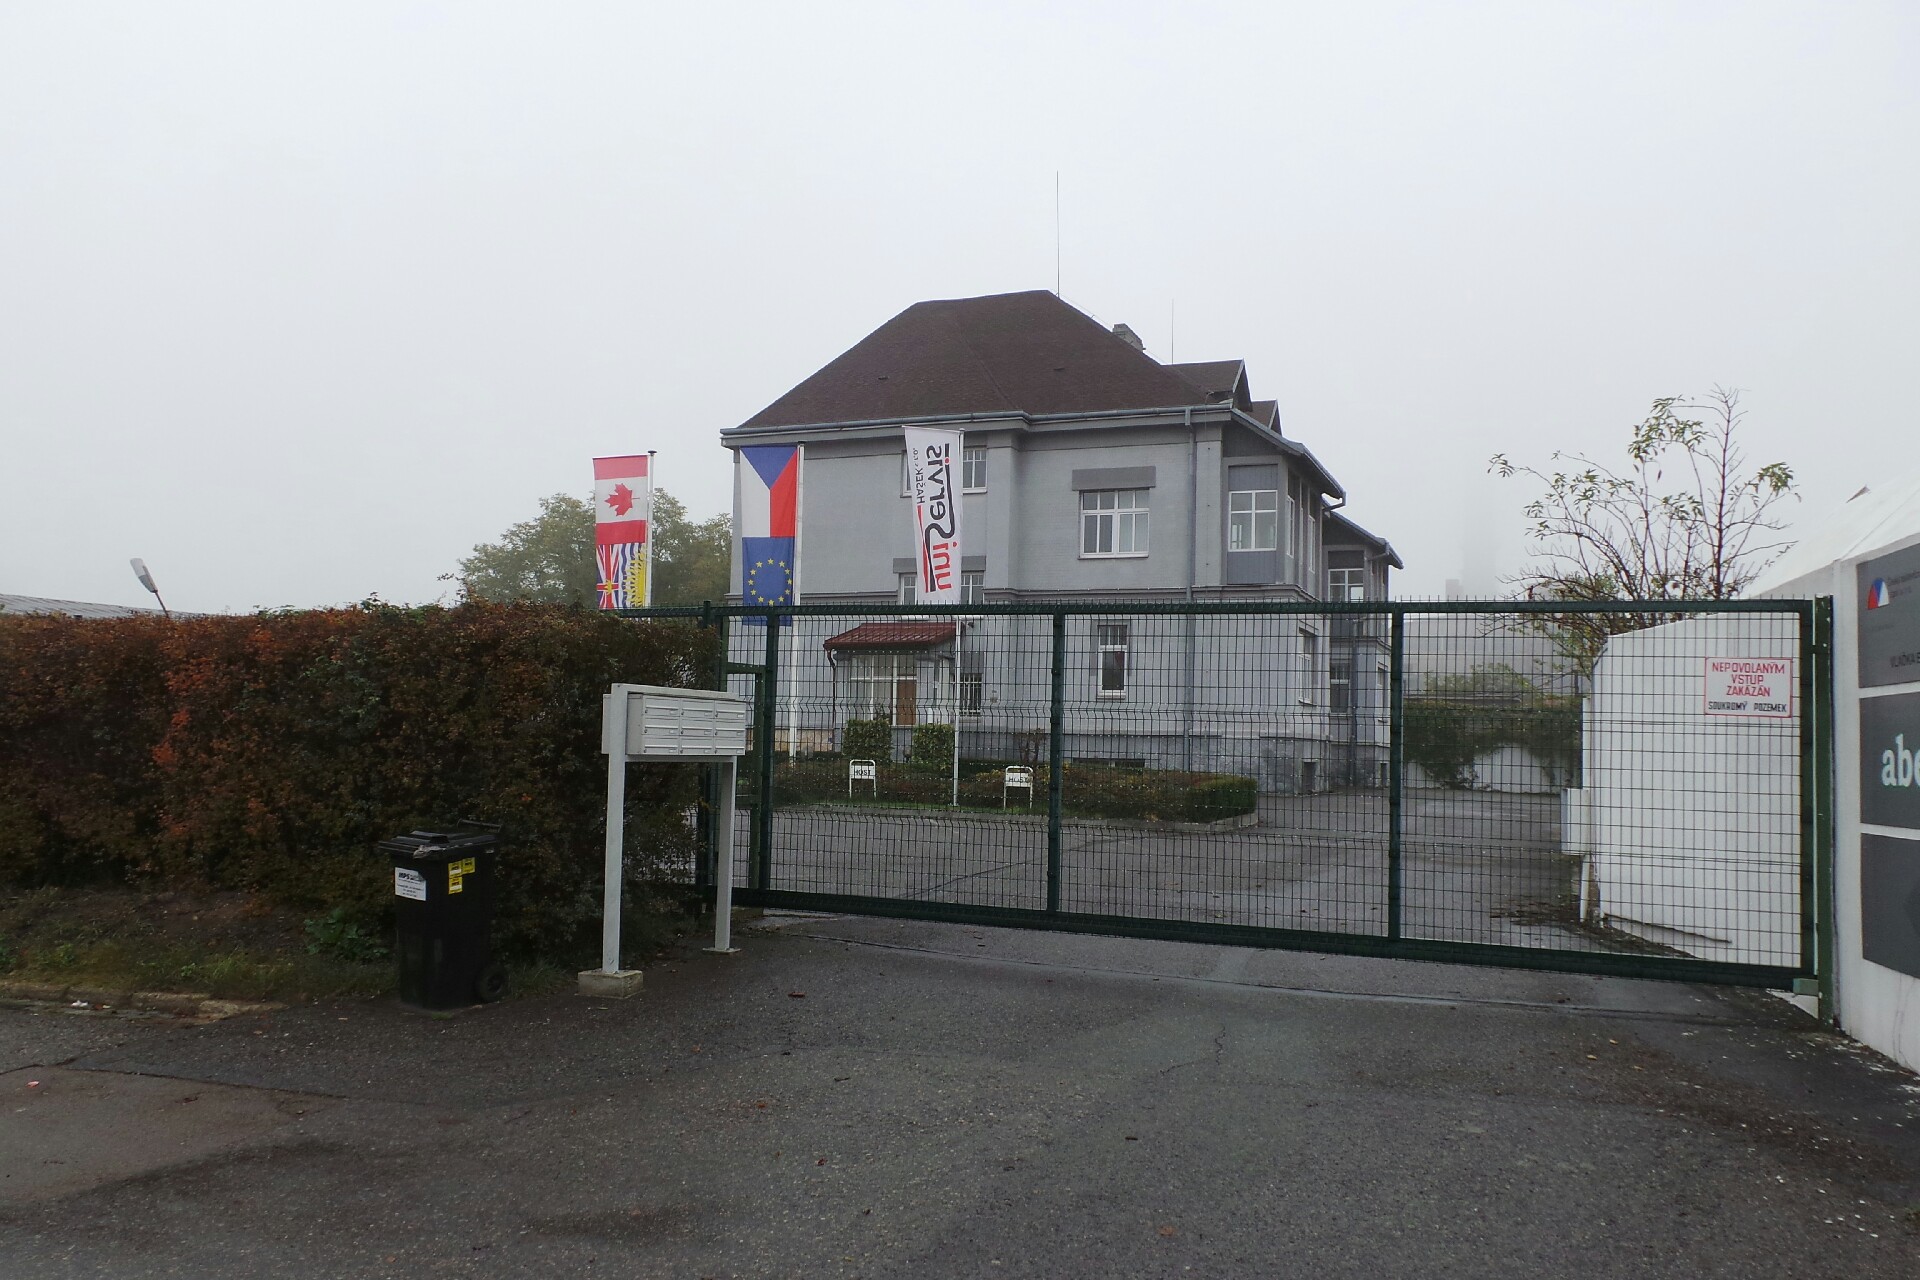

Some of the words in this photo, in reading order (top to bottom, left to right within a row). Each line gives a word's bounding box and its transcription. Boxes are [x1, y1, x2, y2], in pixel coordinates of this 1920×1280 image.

[1712, 662, 1785, 674] NEPOVOLANÝM
[1731, 674, 1764, 684] VSTUP
[1726, 685, 1771, 697] ZAKÁZÁN
[1708, 701, 1747, 711] SOUKROMÝ
[1753, 703, 1787, 712] POZEMEK
